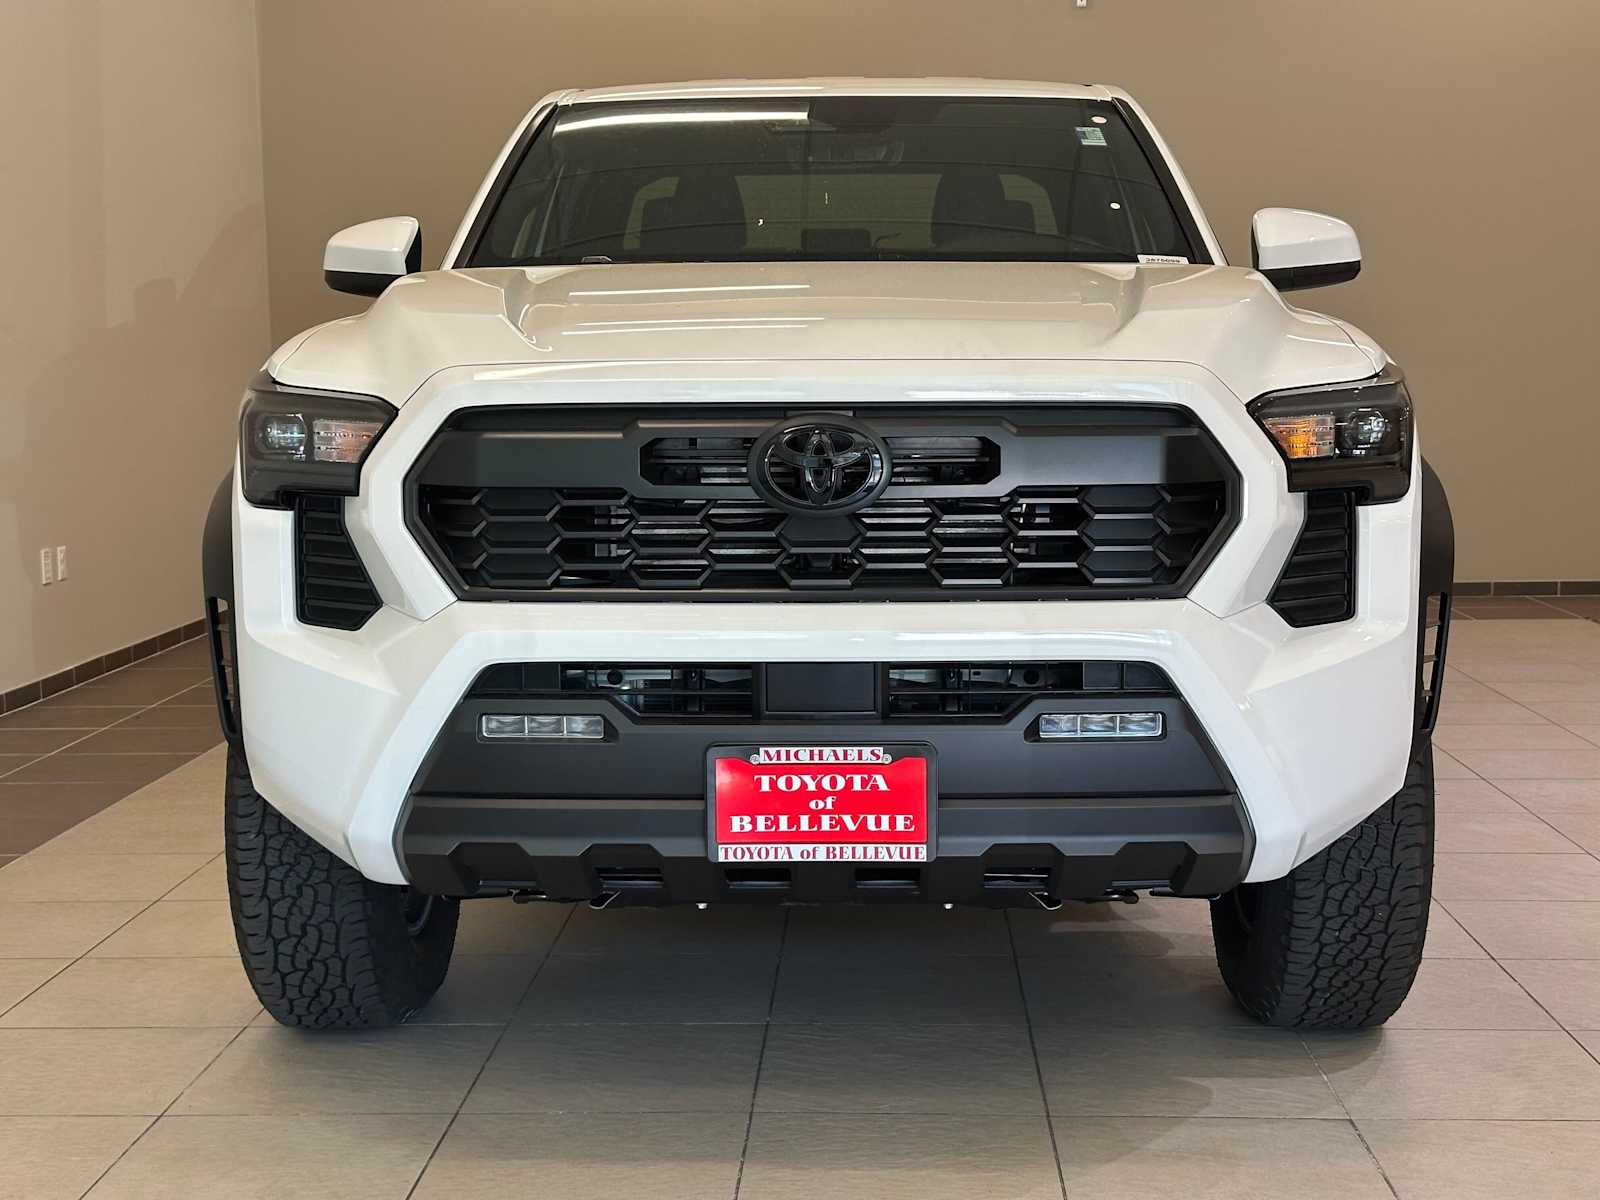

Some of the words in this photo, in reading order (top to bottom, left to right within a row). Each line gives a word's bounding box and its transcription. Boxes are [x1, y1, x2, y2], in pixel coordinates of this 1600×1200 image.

[762, 748, 882, 762] MICHAELS
[754, 774, 890, 792] TOYOTA
[808, 796, 836, 810] of
[730, 814, 915, 832] BELLEVUE
[720, 846, 794, 860] TOYOTA
[799, 846, 819, 860] of
[825, 846, 925, 860] BELLEVUE
